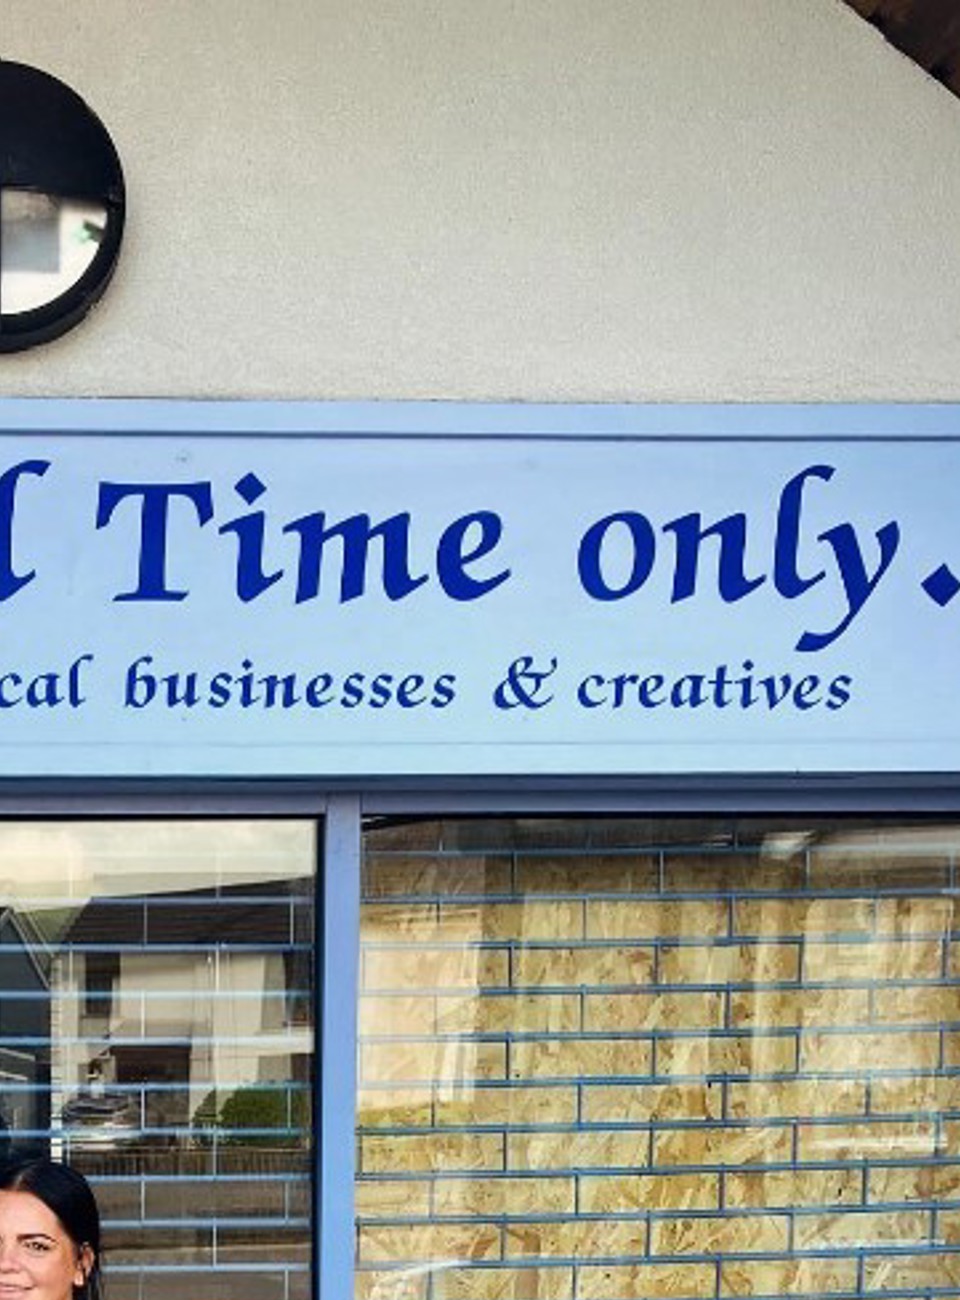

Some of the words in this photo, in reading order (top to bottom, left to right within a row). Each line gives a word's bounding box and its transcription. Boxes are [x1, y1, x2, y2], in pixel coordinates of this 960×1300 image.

[95, 472, 512, 605] Time
[124, 655, 456, 709] businesses
[492, 656, 558, 711] &
[577, 659, 853, 711] creatives
